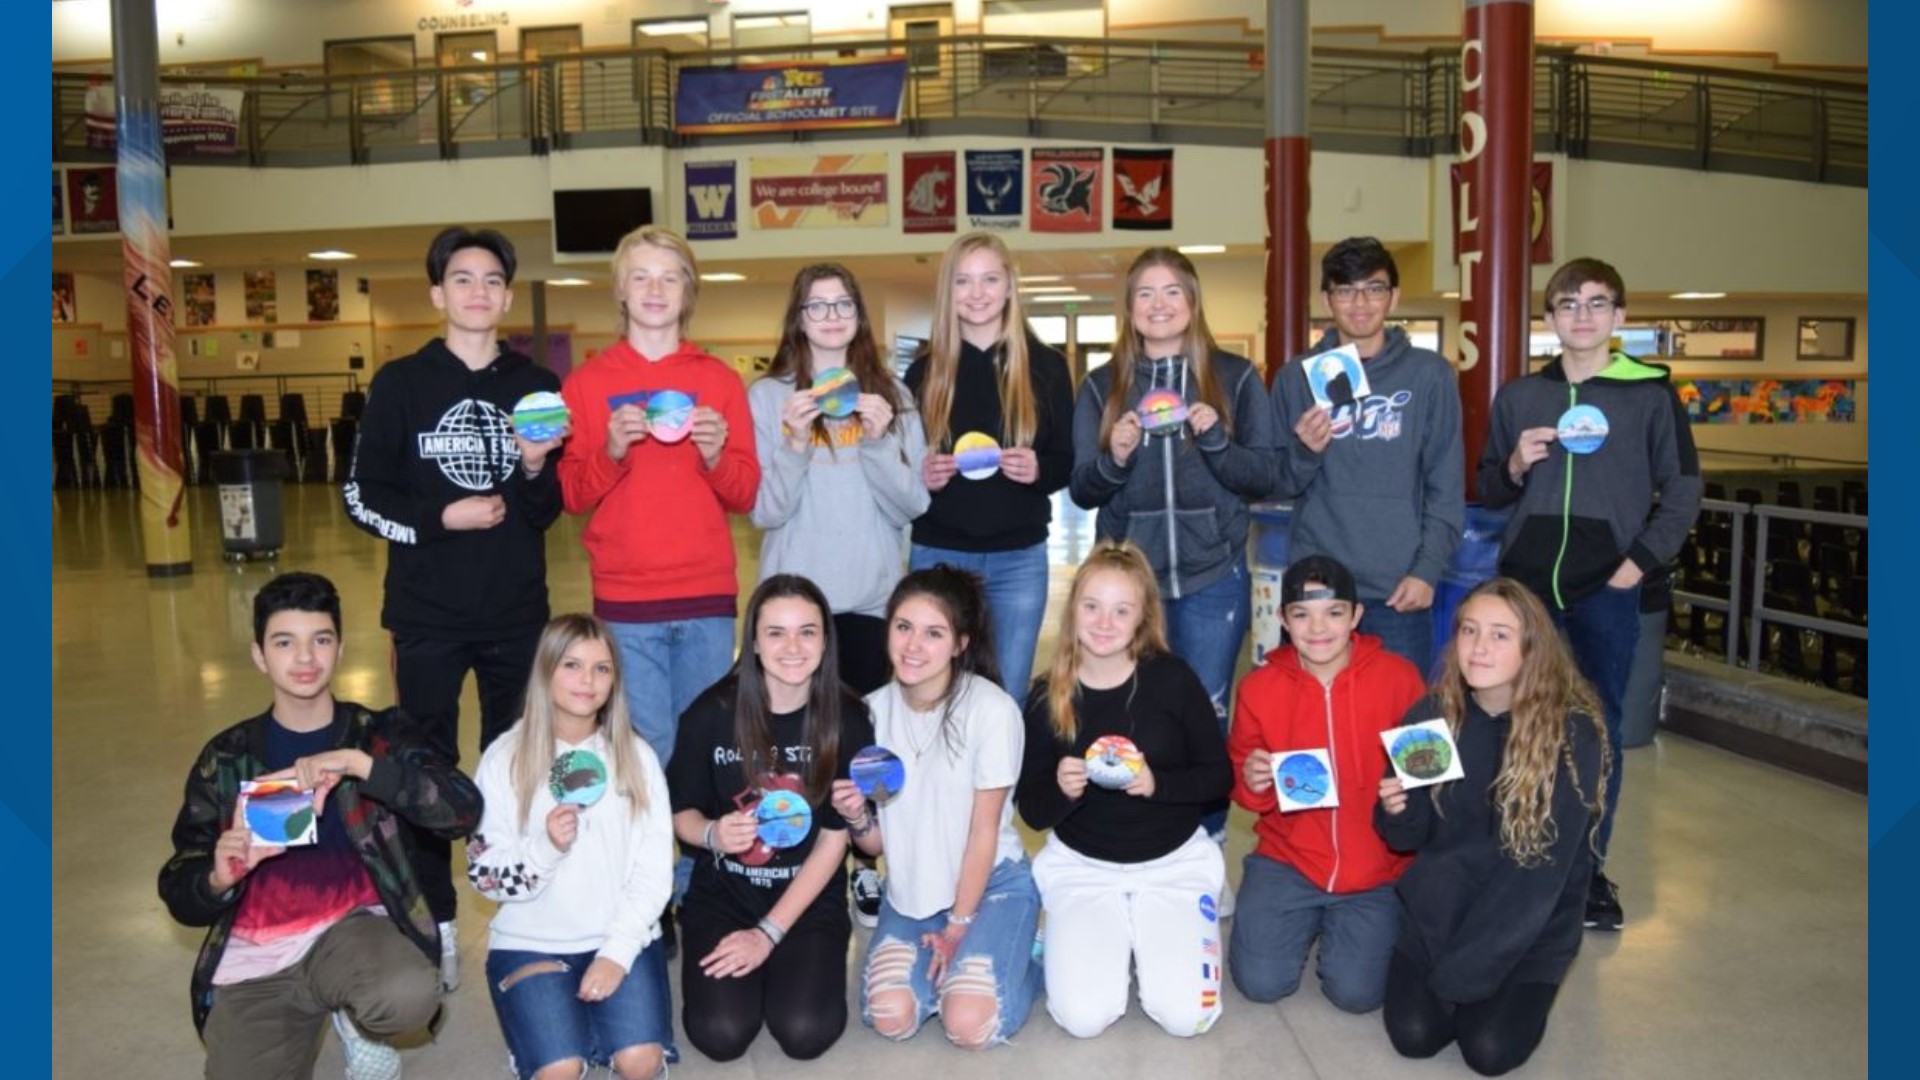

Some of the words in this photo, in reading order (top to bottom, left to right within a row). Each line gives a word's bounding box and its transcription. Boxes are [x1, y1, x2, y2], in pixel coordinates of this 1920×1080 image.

[417, 12, 509, 31] COUNSELING
[708, 111, 762, 123] OFFICIAL
[850, 105, 878, 117] SITE
[756, 184, 777, 198] We
[779, 187, 797, 198] are
[799, 181, 839, 199] college
[1461, 39, 1488, 371] COLTS
[745, 866, 789, 879] AMERICAN
